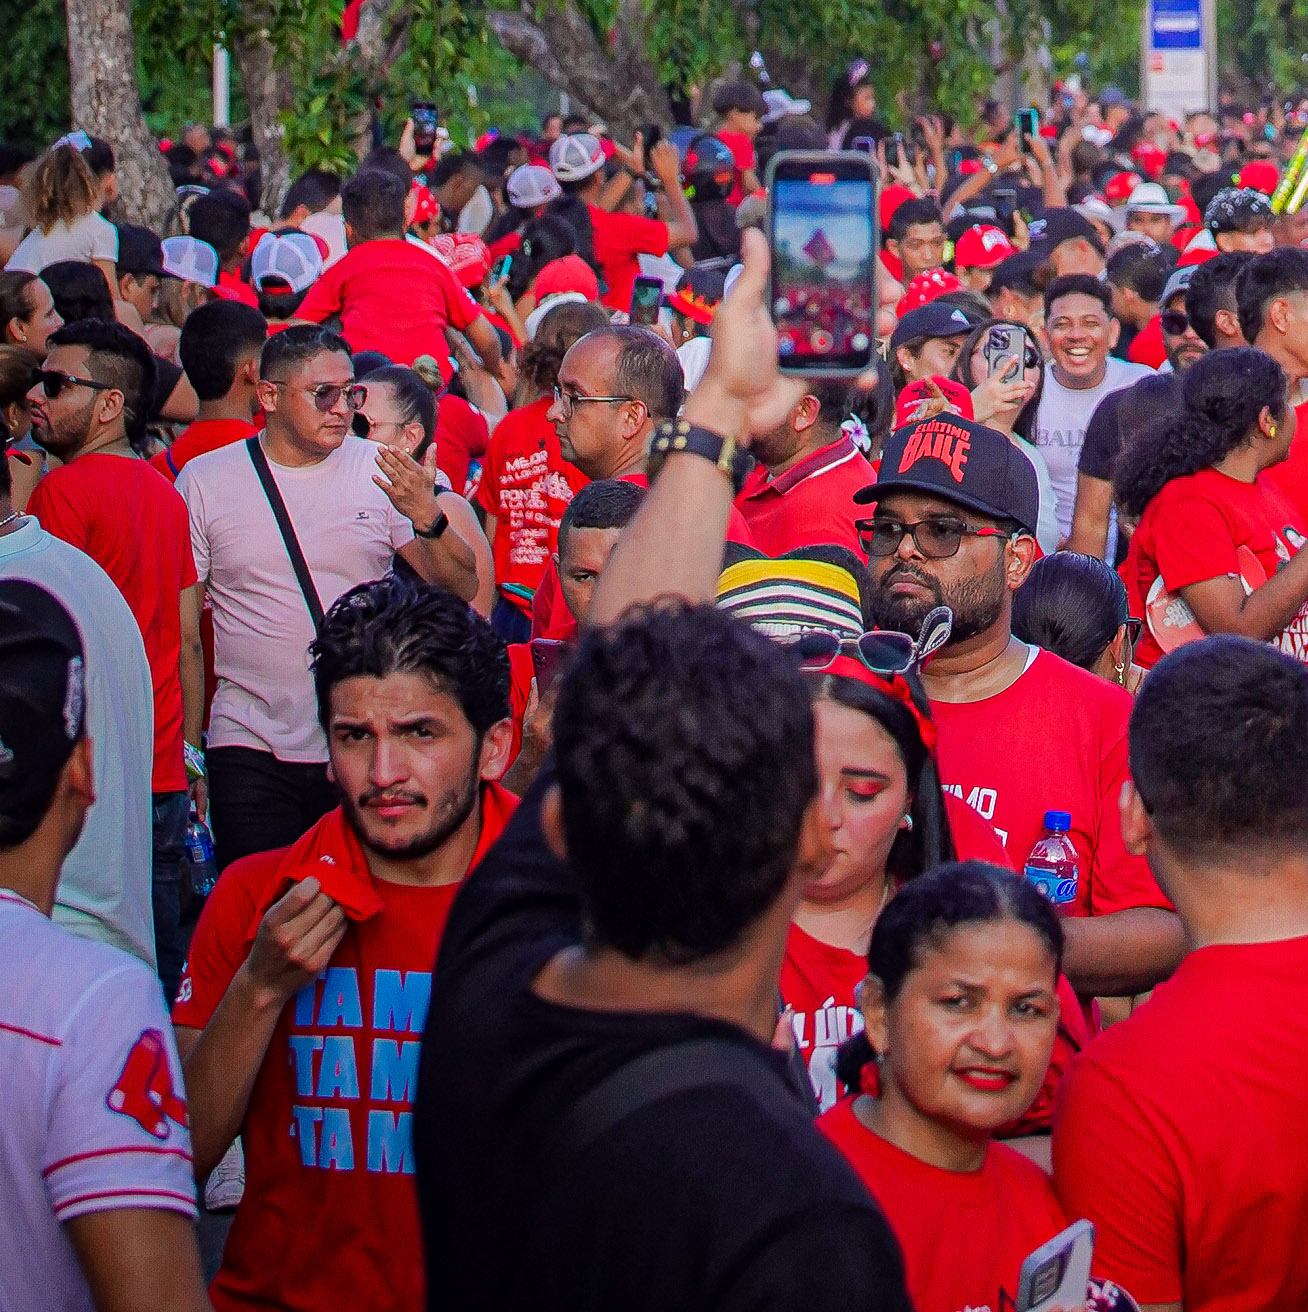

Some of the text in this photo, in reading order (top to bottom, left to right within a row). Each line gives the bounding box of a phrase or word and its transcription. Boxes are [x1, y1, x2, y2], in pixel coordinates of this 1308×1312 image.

[897, 432, 972, 484] BAILE
[288, 1035, 360, 1099] TA
[293, 1104, 356, 1170] TA
